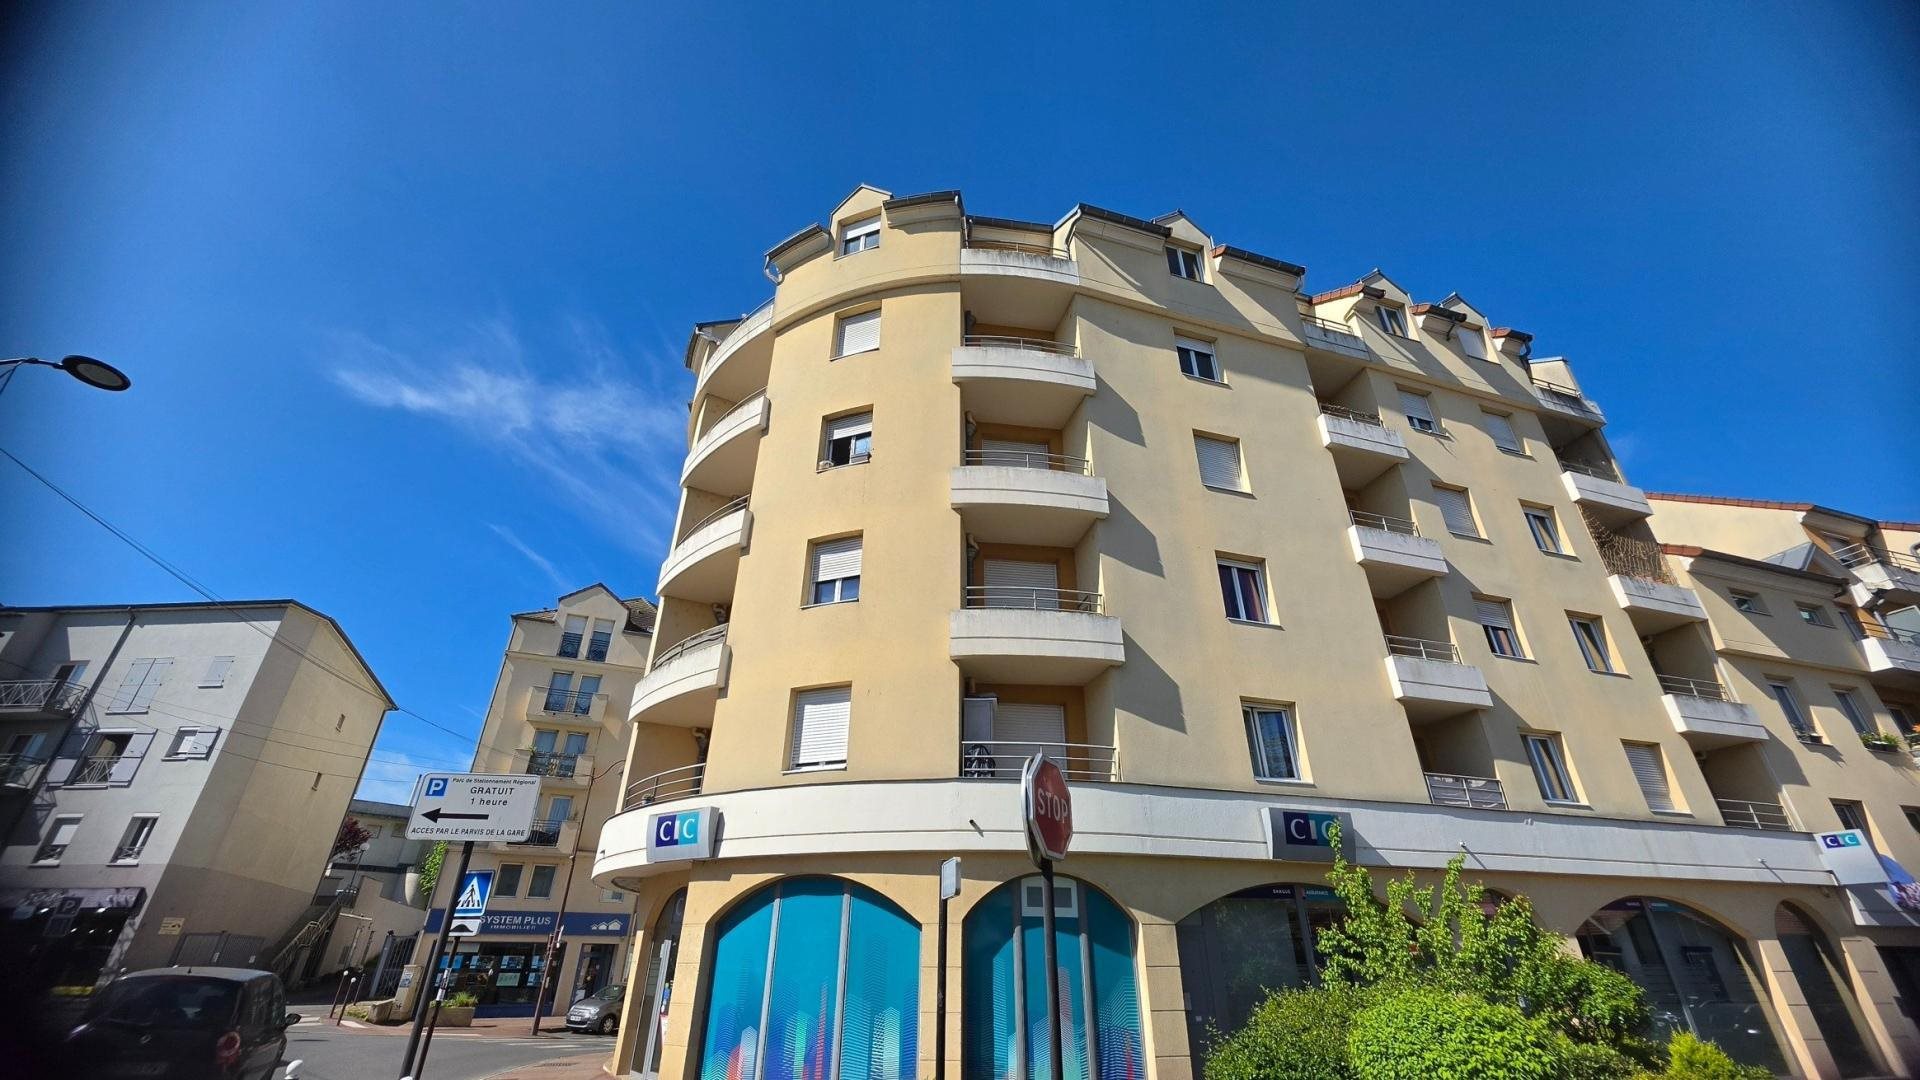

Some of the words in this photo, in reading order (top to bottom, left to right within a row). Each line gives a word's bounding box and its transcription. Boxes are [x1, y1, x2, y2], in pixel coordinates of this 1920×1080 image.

[429, 780, 444, 795] P
[470, 786, 514, 795] GRATUIT
[480, 798, 508, 806] heure
[1038, 788, 1068, 823] STOP
[660, 818, 696, 841] CIC
[1826, 835, 1857, 846] CIC
[480, 915, 522, 925] SYSTEM
[523, 916, 551, 926] PLUS
